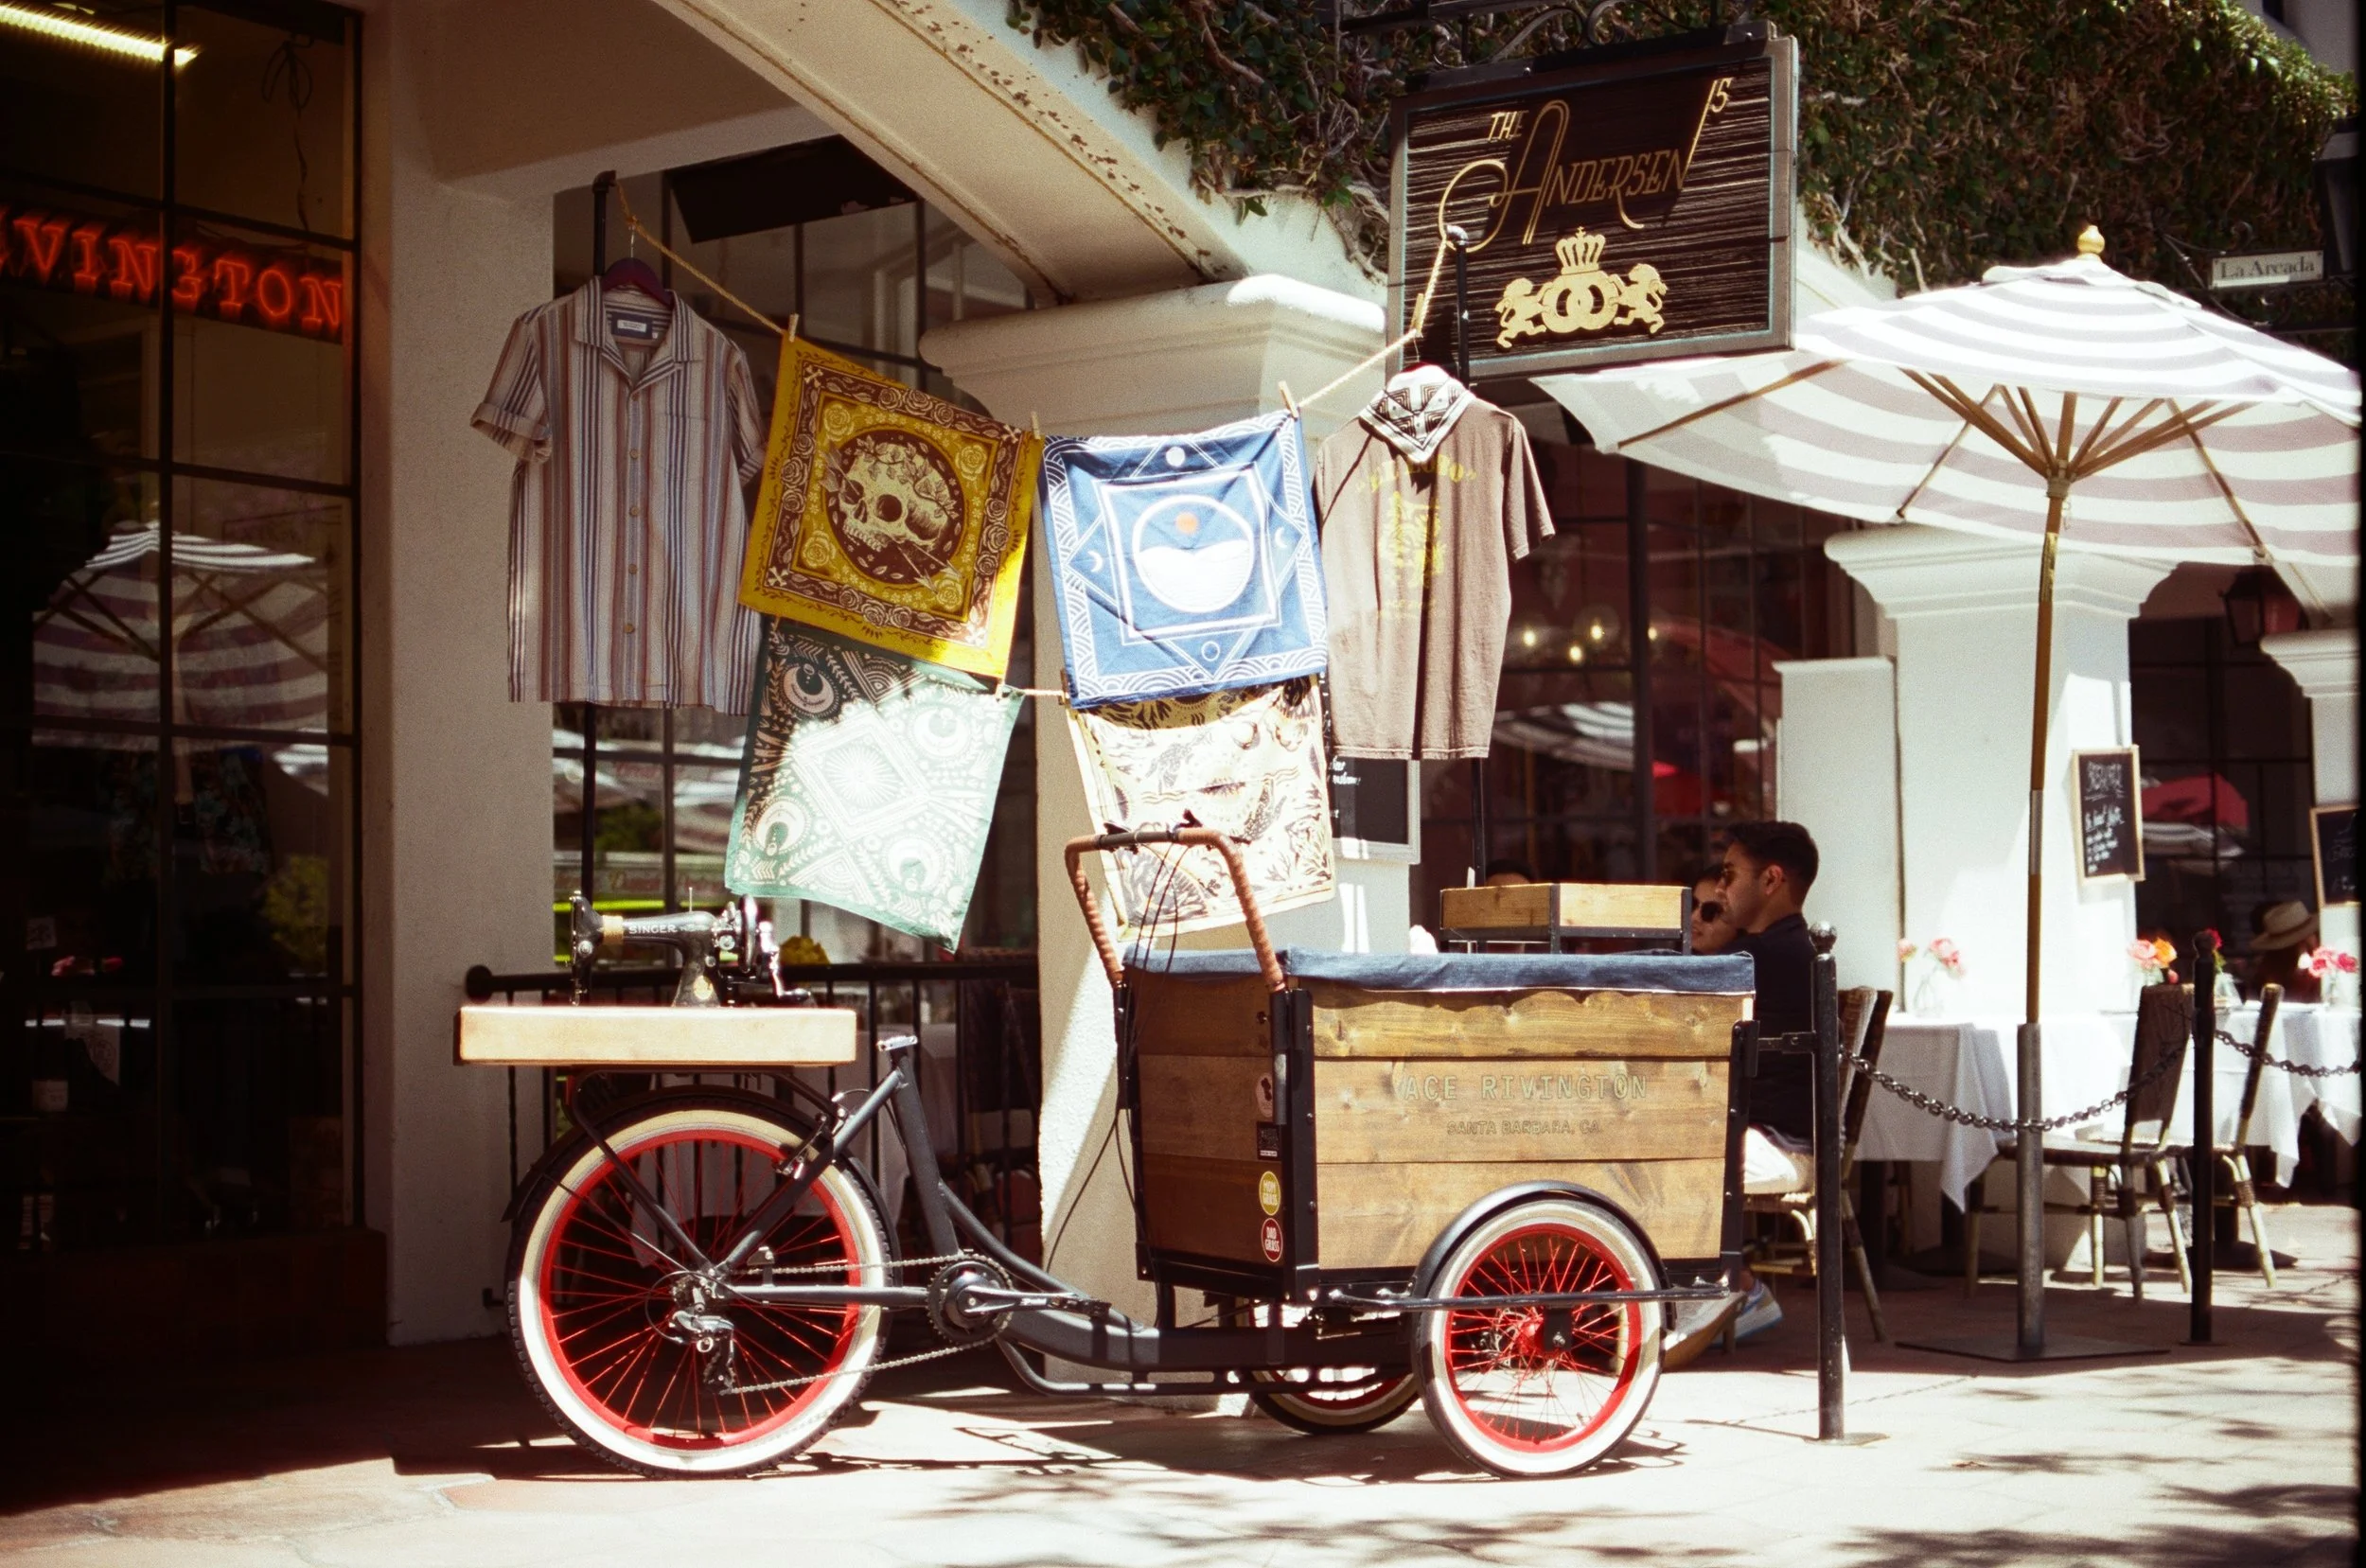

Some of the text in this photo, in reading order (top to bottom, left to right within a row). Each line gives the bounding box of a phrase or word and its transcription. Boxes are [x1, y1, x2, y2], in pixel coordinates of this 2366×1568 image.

[1488, 110, 1528, 142] THE
[0, 210, 344, 329] VINGTON
[2219, 255, 2316, 279] La Arcada
[628, 924, 678, 934] SINGER
[1404, 1073, 1648, 1101] ACE RIVINGTON
[1446, 1120, 1497, 1136] SANTA
